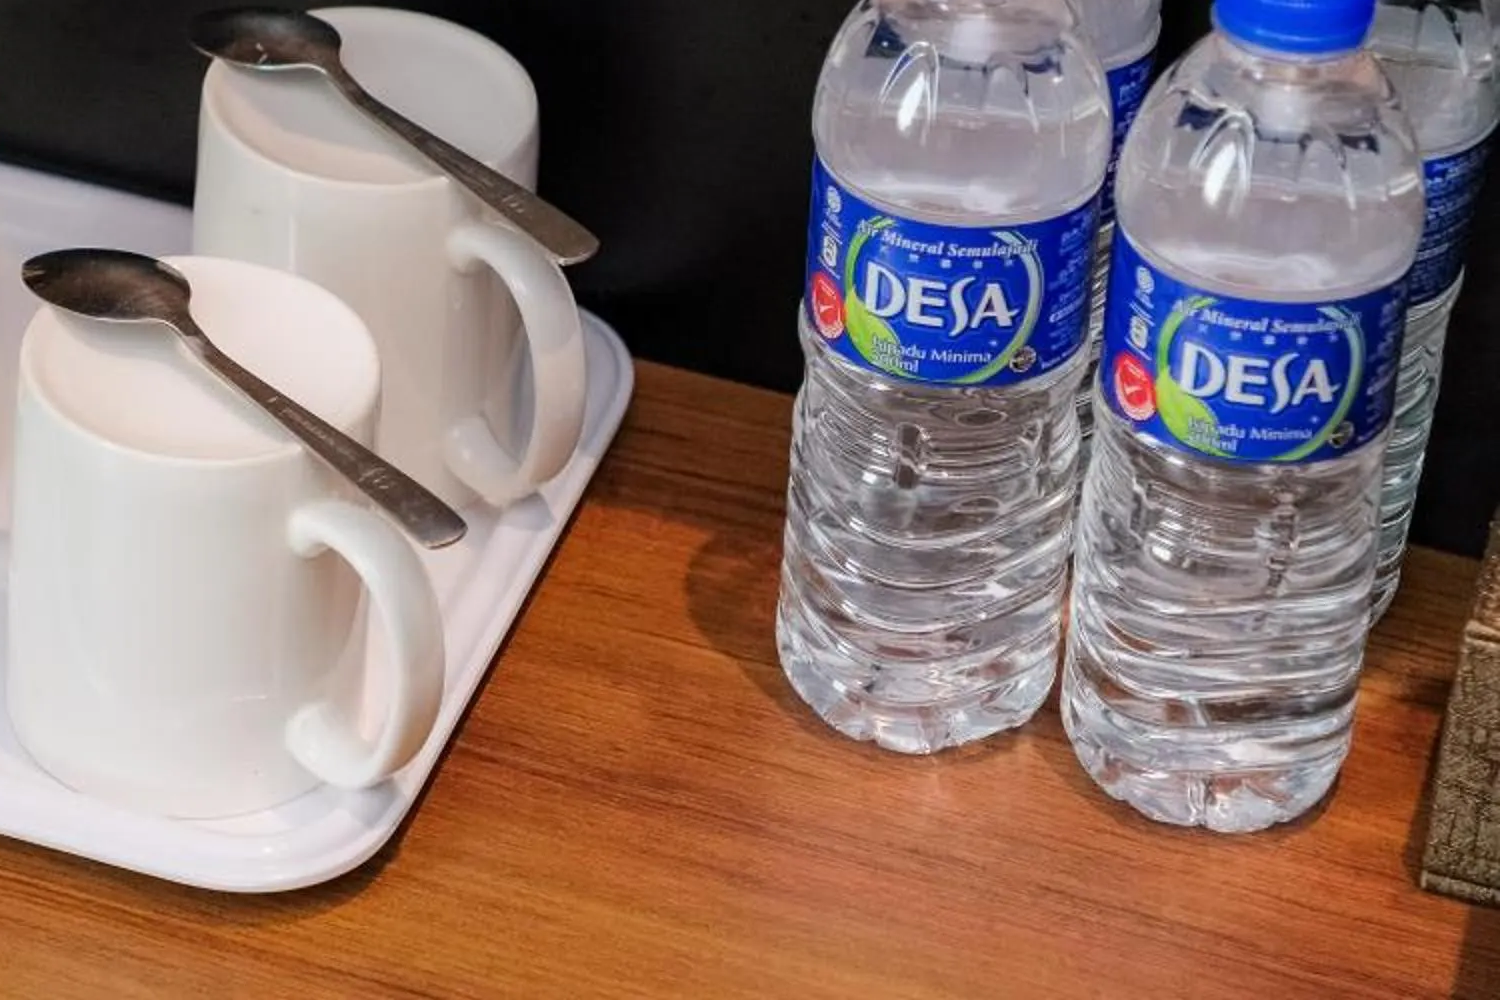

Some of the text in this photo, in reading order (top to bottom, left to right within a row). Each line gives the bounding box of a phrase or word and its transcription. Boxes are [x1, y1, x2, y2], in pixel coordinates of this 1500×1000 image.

[880, 228, 945, 256] Mineral
[864, 261, 1020, 338] DESA
[1200, 307, 1269, 332] Mineral
[930, 347, 993, 364] Minima
[1179, 341, 1340, 415] DESA
[1248, 425, 1314, 441] Minima
